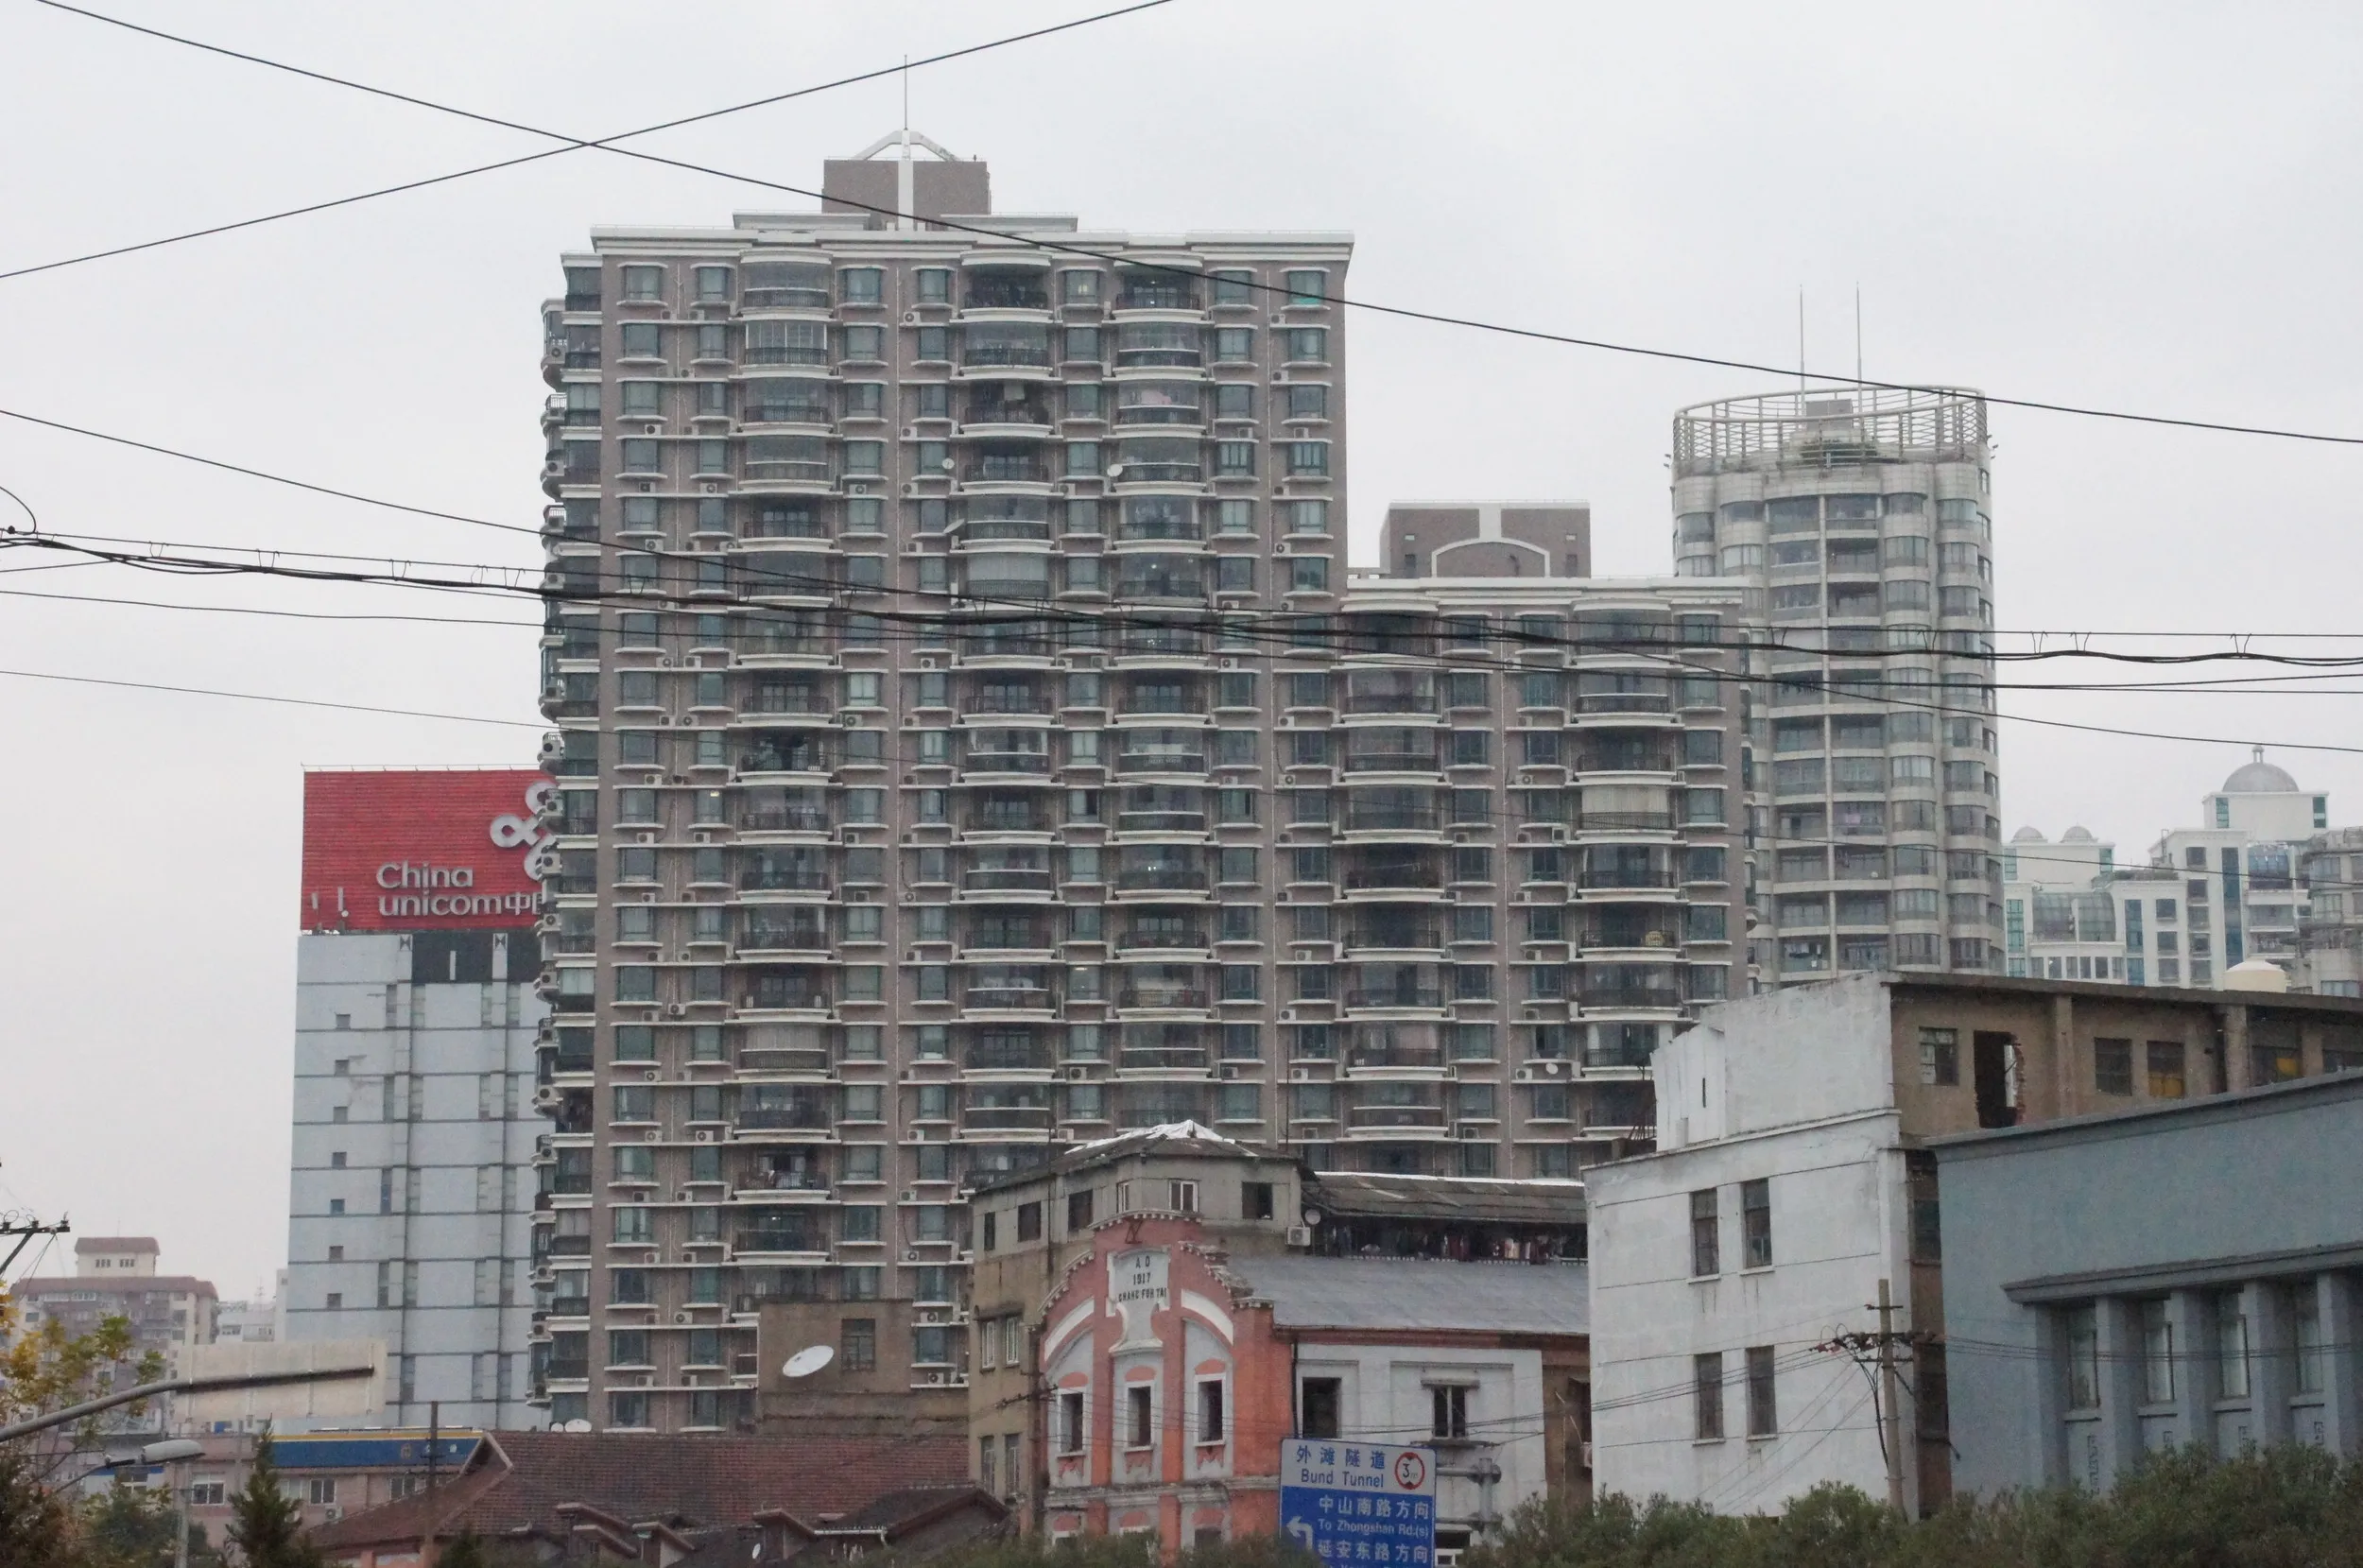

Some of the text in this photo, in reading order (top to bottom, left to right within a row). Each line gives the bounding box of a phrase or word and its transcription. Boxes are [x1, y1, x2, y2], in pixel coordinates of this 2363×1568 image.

[376, 860, 474, 888] China
[378, 889, 502, 916] unicom
[1136, 1257, 1141, 1267] A
[1133, 1271, 1150, 1285] 1917
[1296, 1445, 1385, 1470] 外滩隧道
[1301, 1468, 1384, 1488] Bund Tunnel
[1319, 1494, 1429, 1520] 中山南路方向
[1318, 1518, 1332, 1531] To
[1337, 1519, 1395, 1536] Zhongshan
[1318, 1540, 1428, 1564] 延安东路方向
